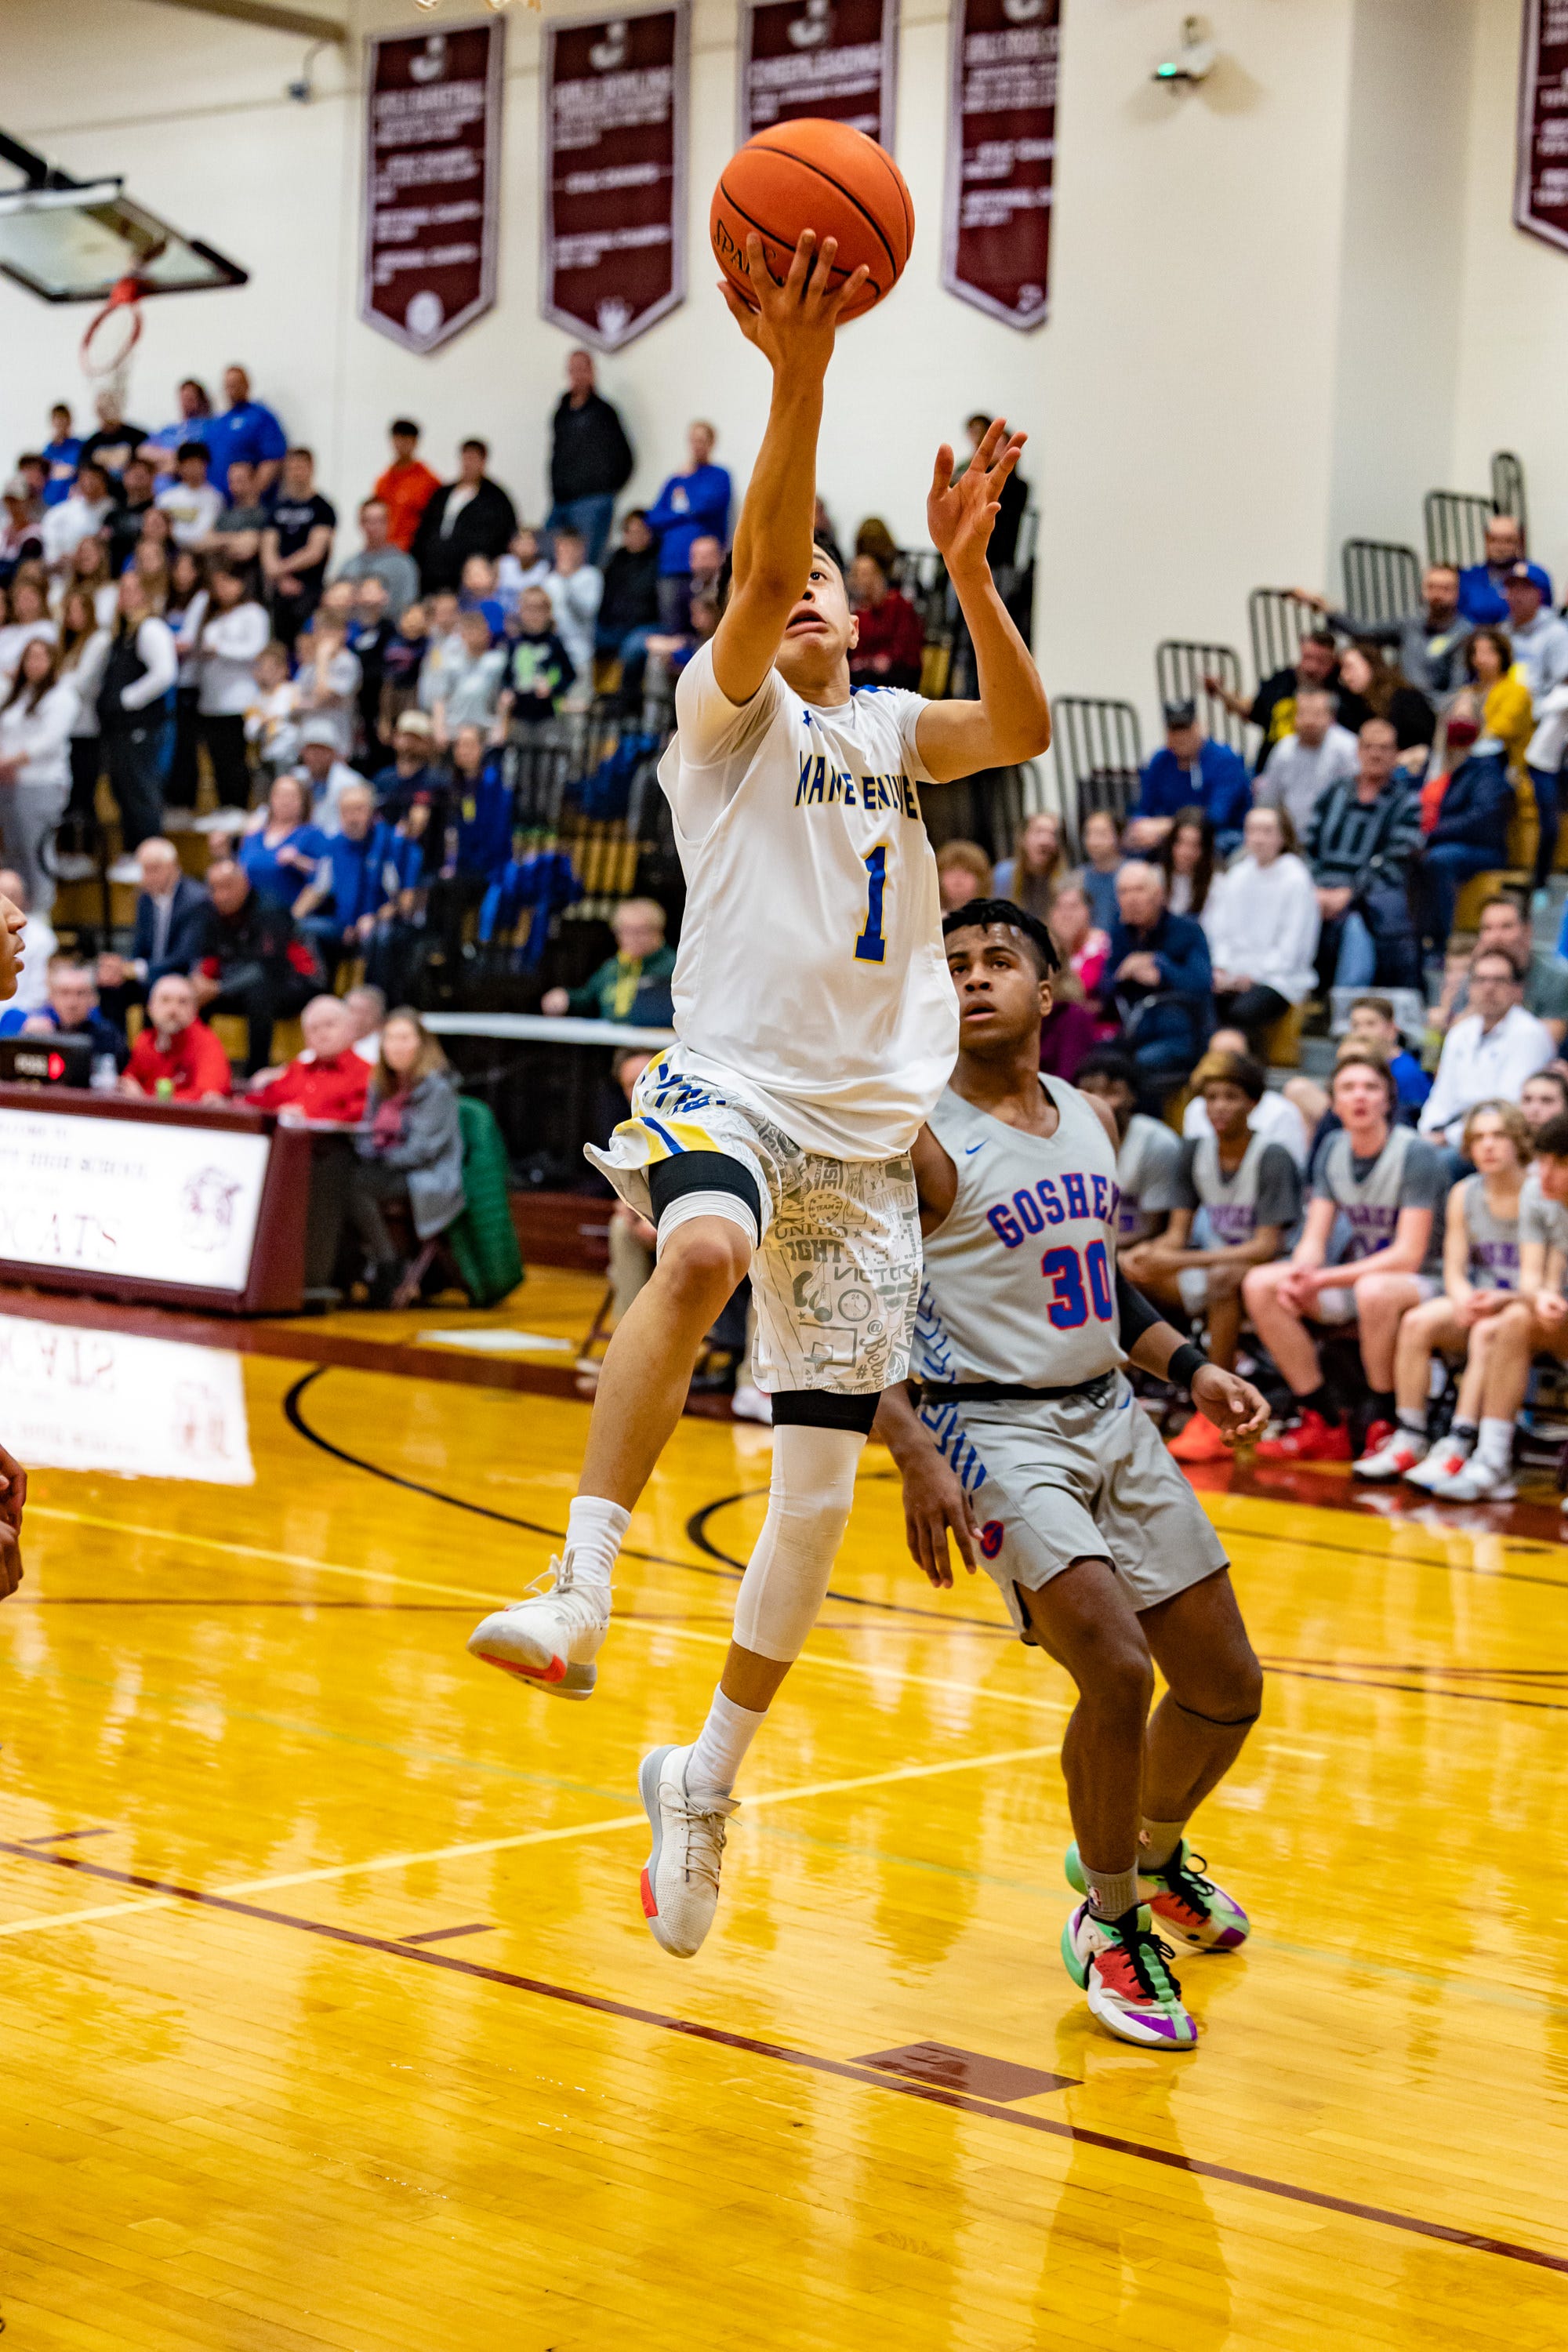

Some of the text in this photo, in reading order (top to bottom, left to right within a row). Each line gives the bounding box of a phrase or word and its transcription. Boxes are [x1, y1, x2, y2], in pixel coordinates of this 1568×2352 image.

[852, 842, 889, 965] 1
[816, 1203, 835, 1212] TEAM
[775, 1223, 848, 1240] UNITED
[783, 1239, 844, 1264] IGHT
[1041, 1239, 1112, 1330] 30
